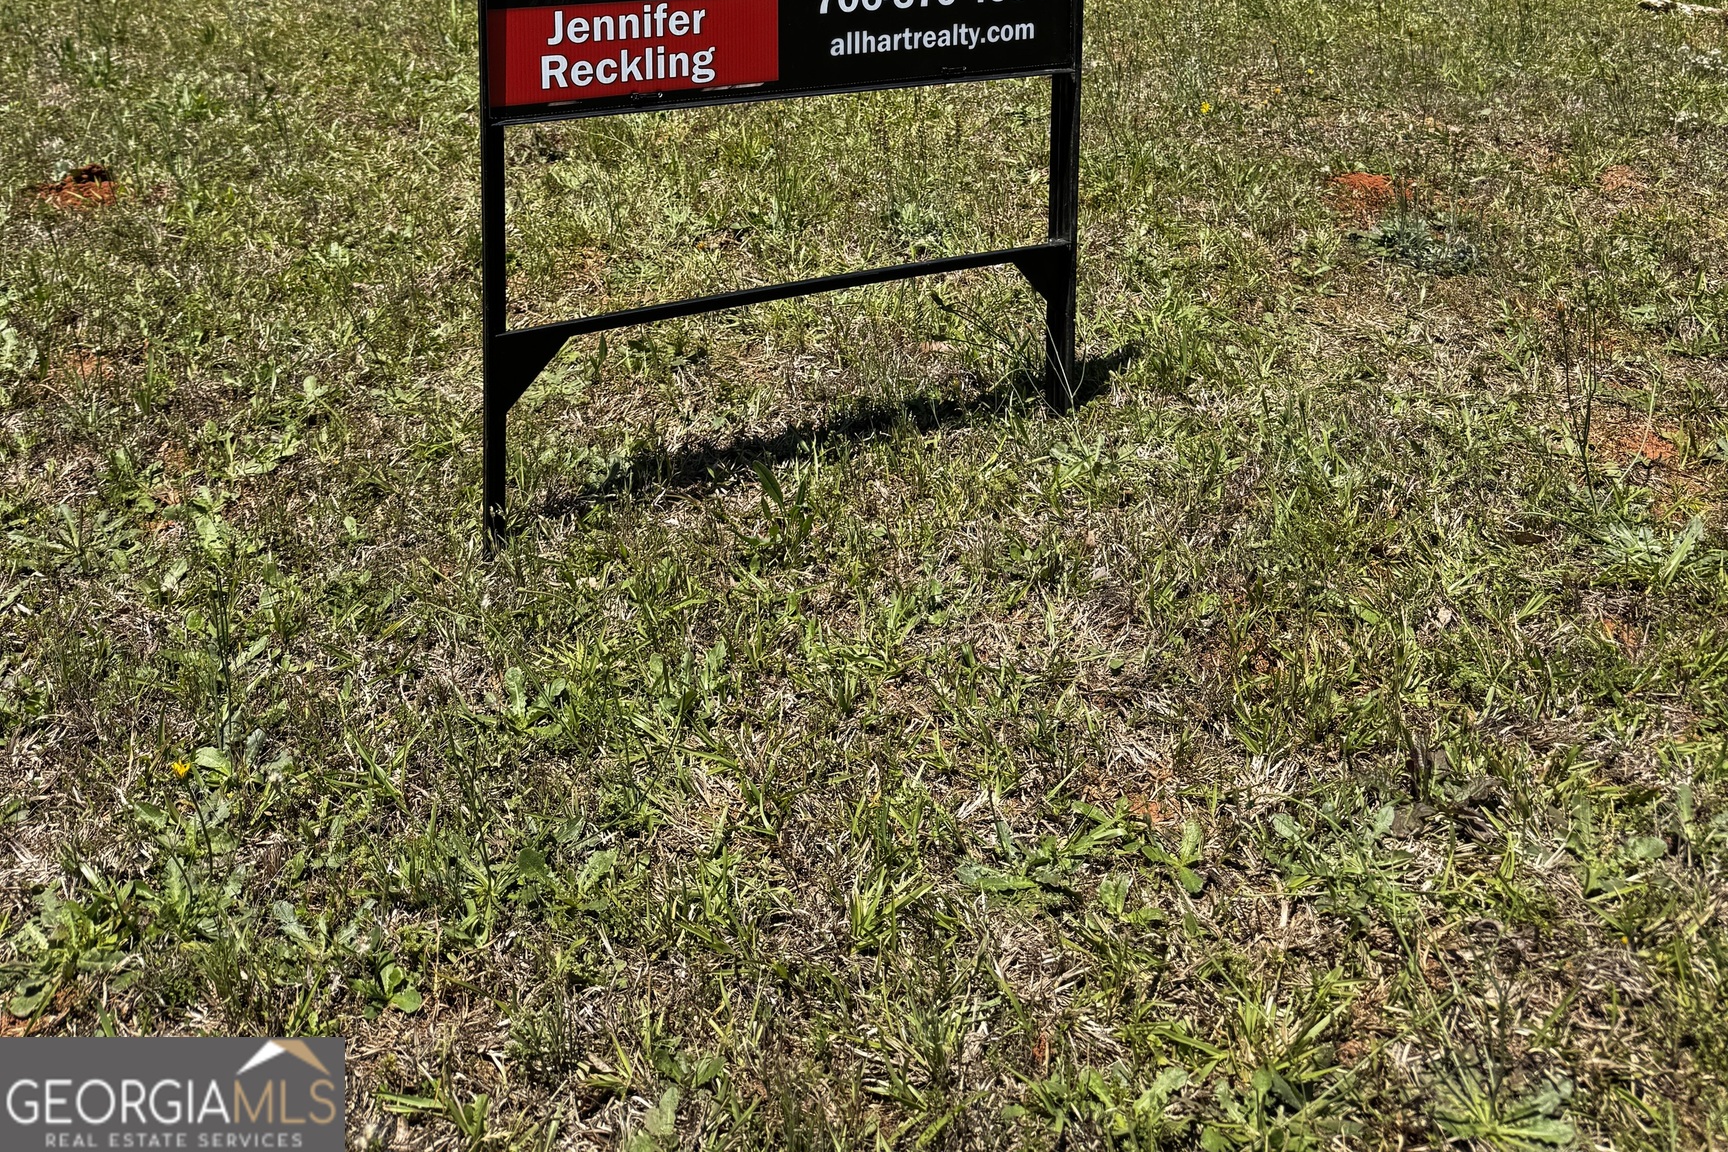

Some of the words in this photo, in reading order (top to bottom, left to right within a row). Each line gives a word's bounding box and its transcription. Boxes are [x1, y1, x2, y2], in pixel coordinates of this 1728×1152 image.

[547, 3, 707, 46] Jennifer
[830, 21, 1036, 57] allhartrealty.com
[540, 46, 716, 90] Reckling
